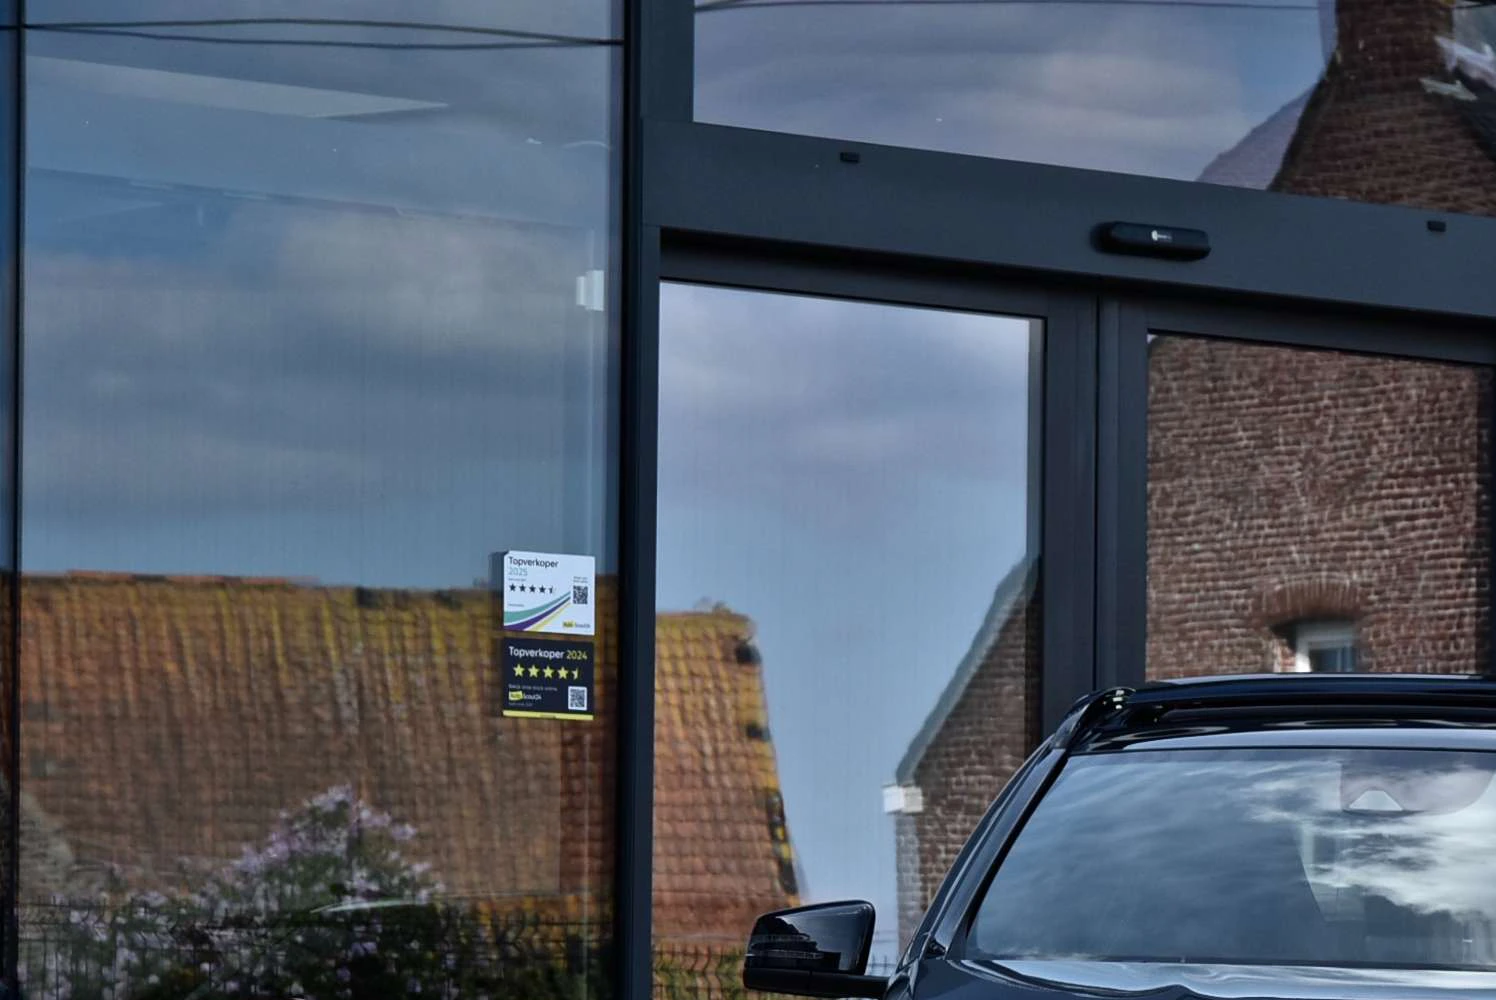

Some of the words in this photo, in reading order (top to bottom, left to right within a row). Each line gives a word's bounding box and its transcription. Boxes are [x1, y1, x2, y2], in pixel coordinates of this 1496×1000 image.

[508, 556, 559, 569] Topverkoper
[508, 567, 528, 577] 2025
[508, 646, 565, 660] Topverkoper
[566, 649, 588, 660] 2024
